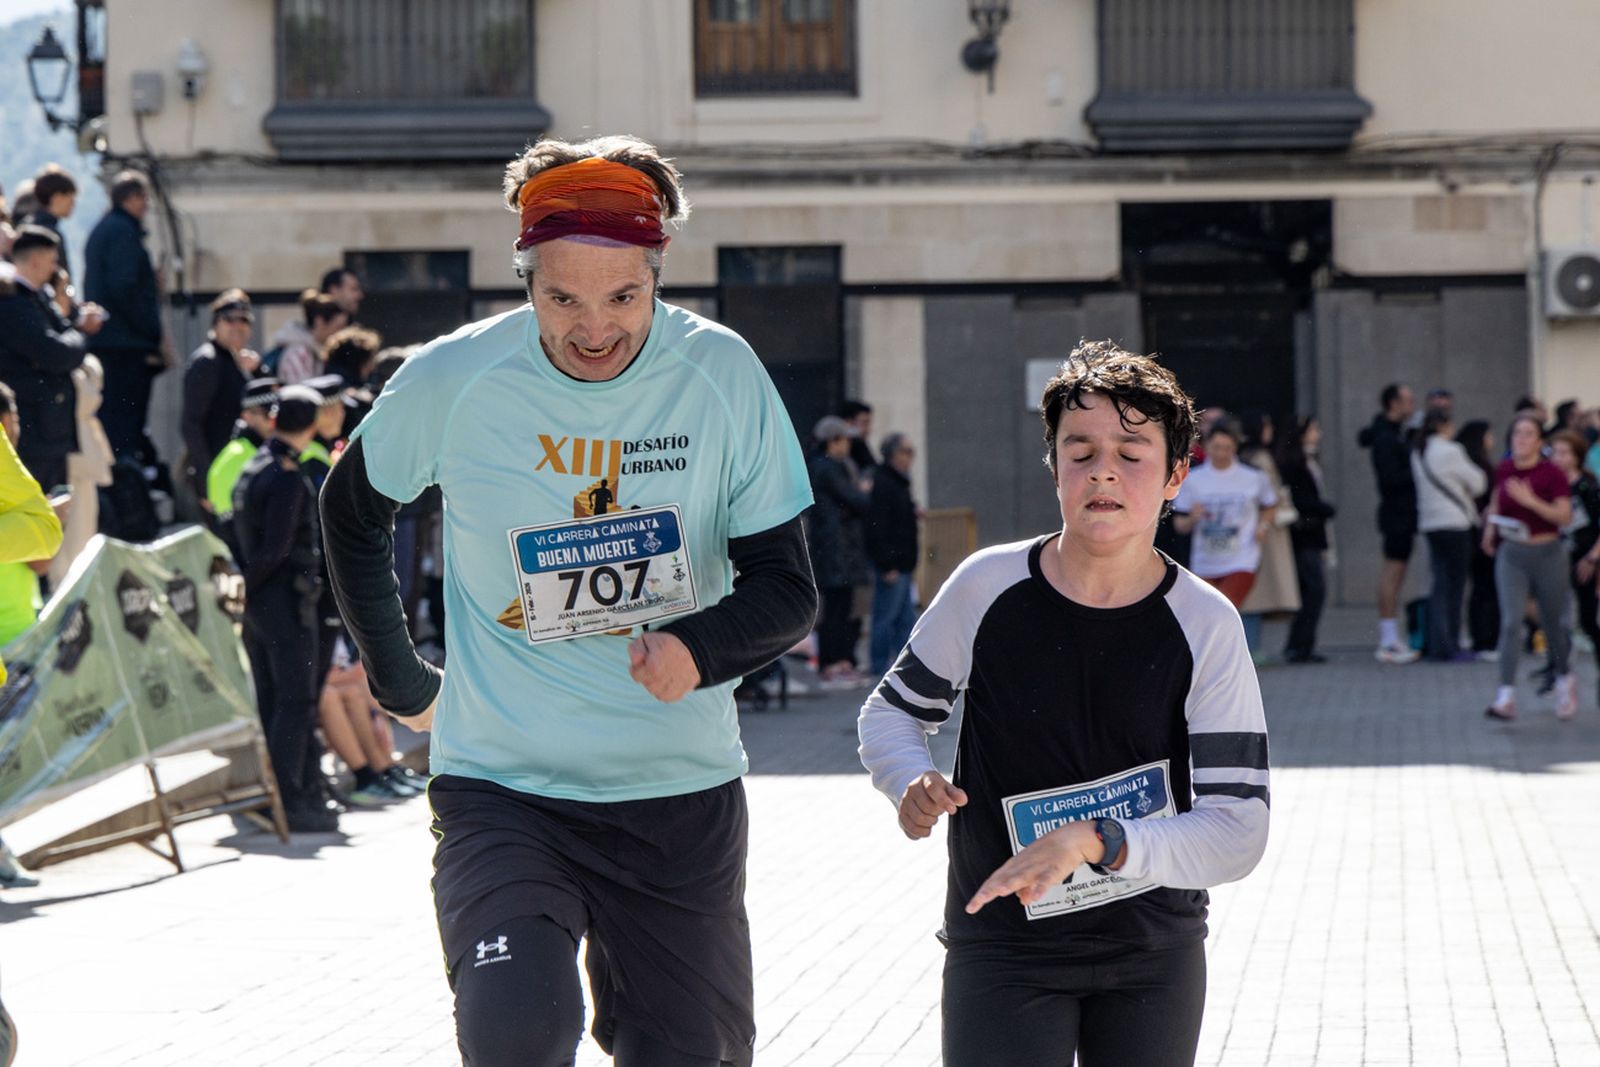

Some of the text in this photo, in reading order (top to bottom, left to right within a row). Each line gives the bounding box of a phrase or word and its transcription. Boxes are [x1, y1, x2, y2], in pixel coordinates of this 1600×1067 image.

[534, 434, 622, 477] XIII
[623, 433, 689, 455] DESAFÍO
[621, 457, 687, 475] URBANO
[534, 518, 660, 547] VI CARRERA CAMINATA
[537, 538, 638, 568] BUENA MUERTE
[558, 560, 651, 611] 707
[557, 611, 576, 621] JUAN
[576, 608, 605, 618] ARSENIO
[1030, 775, 1149, 816] VI CARRERA CAMINATA
[1066, 882, 1089, 893] ANGEL
